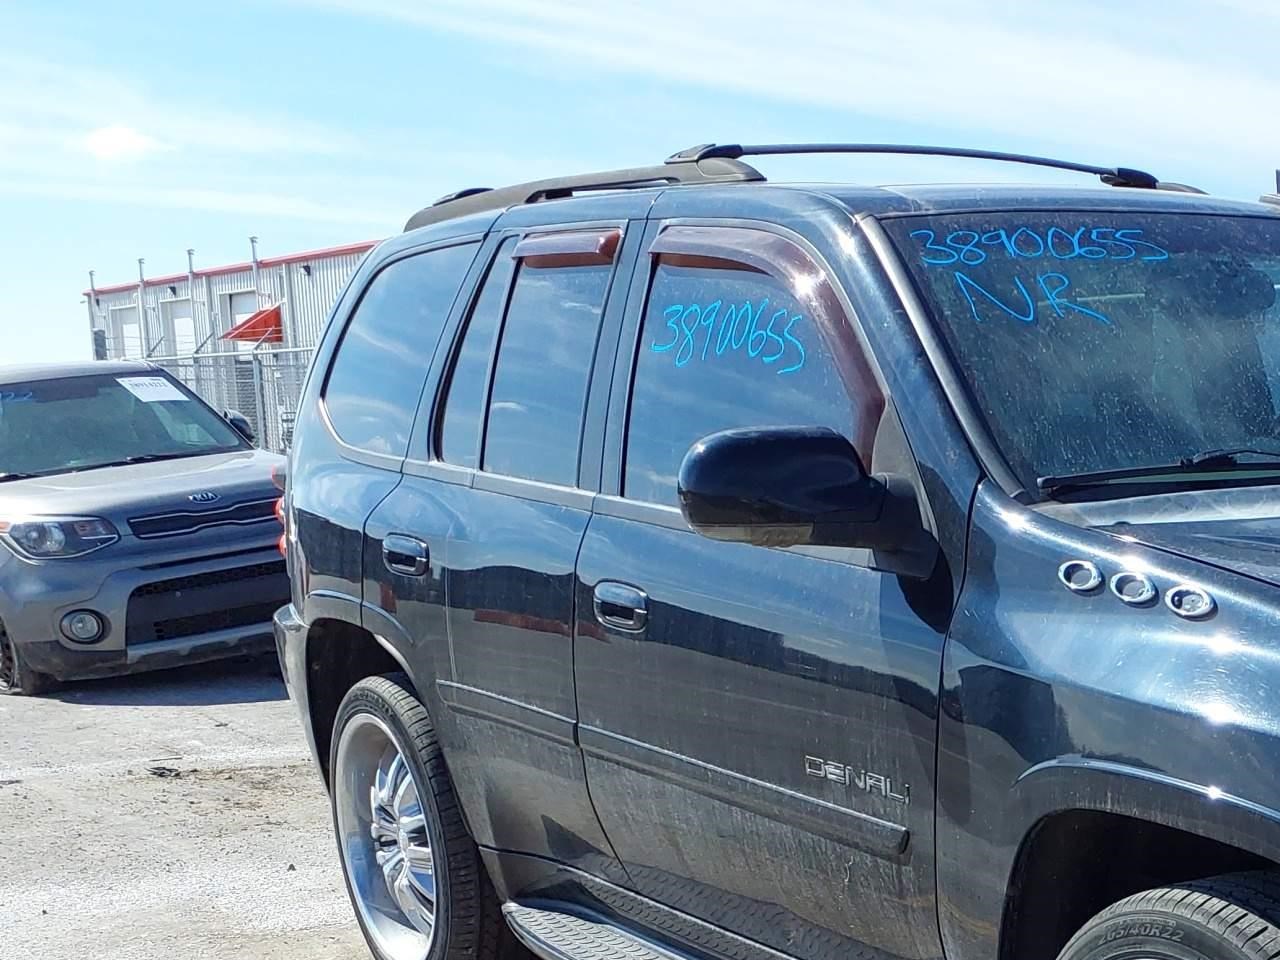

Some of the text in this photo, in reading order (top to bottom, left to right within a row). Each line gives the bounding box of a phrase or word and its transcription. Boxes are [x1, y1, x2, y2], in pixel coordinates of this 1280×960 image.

[910, 226, 1169, 265] 38900655
[651, 298, 805, 374] 38900655
[804, 755, 911, 805] DENALI
